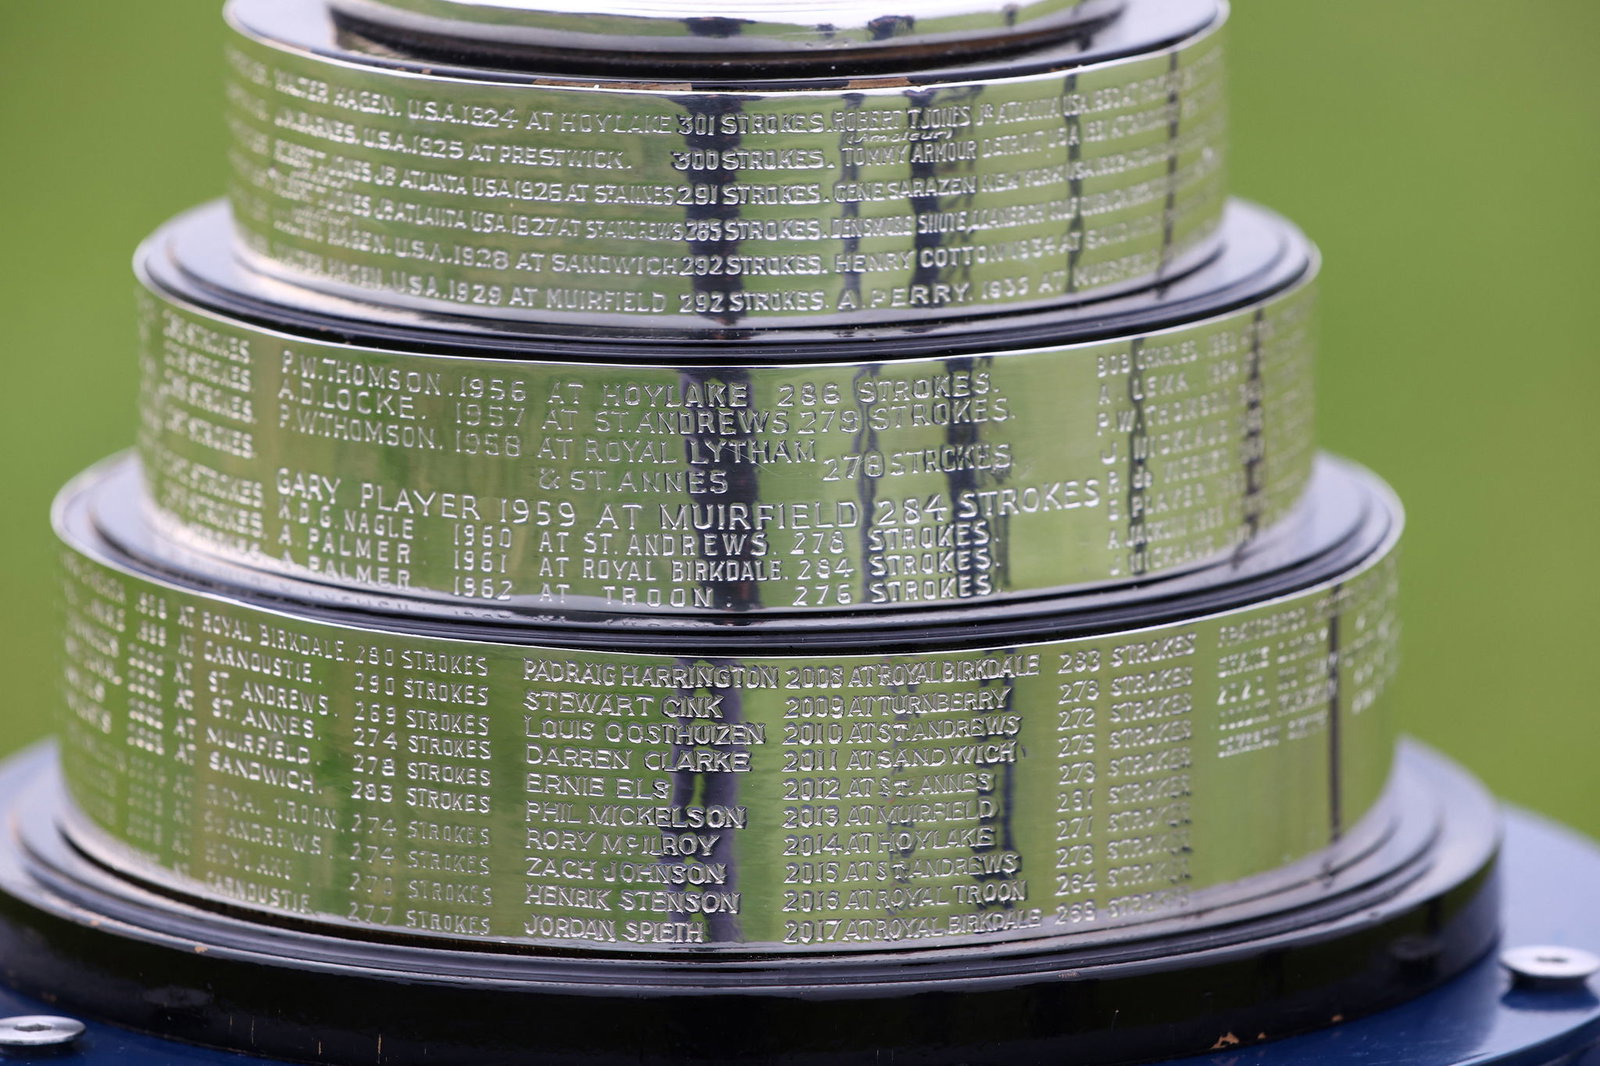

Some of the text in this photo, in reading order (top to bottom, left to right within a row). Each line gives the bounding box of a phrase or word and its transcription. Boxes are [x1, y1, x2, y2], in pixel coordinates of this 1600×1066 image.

[526, 111, 553, 131] AT
[561, 113, 672, 134] HOYLAKE
[677, 114, 715, 136] 301
[468, 143, 493, 162] AT
[671, 150, 719, 171] 300
[841, 140, 977, 166] TOMMY ARMOUR
[565, 184, 717, 206] AT 291
[888, 176, 977, 199] SARAZEN
[558, 219, 581, 237] AT
[516, 253, 723, 276] AT SANDWICH 292
[834, 244, 1003, 274] HENRY COTTON
[509, 287, 538, 307] AT
[547, 287, 667, 312] MUIRFIELD
[679, 291, 725, 313] 292
[459, 376, 526, 401] 1956
[548, 381, 583, 404] AT
[603, 383, 749, 408] HOYLAKE
[777, 382, 841, 407] 286
[858, 373, 999, 403] STROKES.
[455, 402, 525, 427] 1957
[541, 408, 578, 431] AT
[798, 409, 860, 434] 279
[455, 429, 521, 457] 1958
[537, 437, 574, 460] AT
[585, 438, 677, 464] ROYAL
[689, 439, 816, 465] LYTHAM
[539, 467, 560, 491] &
[277, 467, 341, 505] GARY
[360, 482, 481, 521] PLAYER
[500, 498, 576, 528] 1959
[596, 503, 643, 530] AT
[659, 502, 858, 531] MUIRFIELD
[877, 493, 948, 526] 284
[958, 479, 1100, 518] STROKES
[308, 528, 411, 565] PALMER
[454, 550, 506, 575] 1961
[539, 557, 569, 578] AT
[583, 558, 656, 581] ROYAL
[672, 559, 789, 582] BIRKDALE.
[798, 558, 855, 581] 284
[454, 523, 512, 549] 1960
[539, 531, 569, 553] AT
[790, 531, 845, 555] 278
[454, 576, 513, 602] 1962
[539, 583, 570, 604] AT
[792, 584, 852, 607] 276
[354, 645, 395, 668] 280
[401, 650, 489, 677] STROKES
[523, 657, 617, 686] PADRAIG
[621, 664, 779, 689] HARRINGTON
[785, 666, 844, 689] 2008
[848, 665, 876, 688] AT
[877, 661, 941, 687] ROYAL
[942, 654, 1040, 684] BIRKDALE
[1110, 633, 1196, 668] STROKES
[403, 678, 489, 707] STROKES
[523, 690, 655, 716] STEWART
[661, 695, 724, 719] CINK
[784, 695, 844, 719] 2009
[847, 695, 876, 717] AT
[876, 687, 1012, 716] TURNBERRY
[354, 700, 490, 736] 269 STROKES
[524, 714, 595, 740] LOUIS
[605, 721, 766, 745] OOSTHUIZEN
[782, 722, 843, 746] 2010
[846, 722, 875, 744] AT
[1057, 707, 1095, 731] 272
[353, 727, 397, 750] 274
[408, 735, 492, 760] STROKES
[526, 743, 633, 770] DARREN
[644, 750, 752, 772] CLARKE
[782, 749, 838, 773] 2011
[845, 749, 875, 771] AT
[876, 741, 1018, 769] SANDWICH
[1057, 734, 1095, 758] 275
[353, 754, 491, 787] 278 STROKES
[526, 772, 875, 801] ERNIE ELS 2012 AT
[406, 787, 490, 814] STROKES
[526, 797, 999, 829] PHIL MICKELSON 2013 AT MUIRFIELD
[351, 814, 490, 846] 274 STROKES
[526, 827, 596, 851] RORY
[782, 833, 842, 856] 2014
[844, 832, 874, 855] AT
[877, 827, 997, 854] HOYLAKE
[1056, 815, 1093, 841] 271
[350, 842, 489, 876] 274 STROKES
[525, 857, 873, 885] ZACH JOHNSON 2015 AT
[408, 880, 492, 906] STROKES
[524, 870, 1097, 914] HENRIK STENSON 2016 AT ROYAL TROON 264
[349, 902, 490, 935] 277 STROKES
[524, 909, 1042, 944] JORDAN SPIETH 2017 AT ROYAL BIRKDALE
